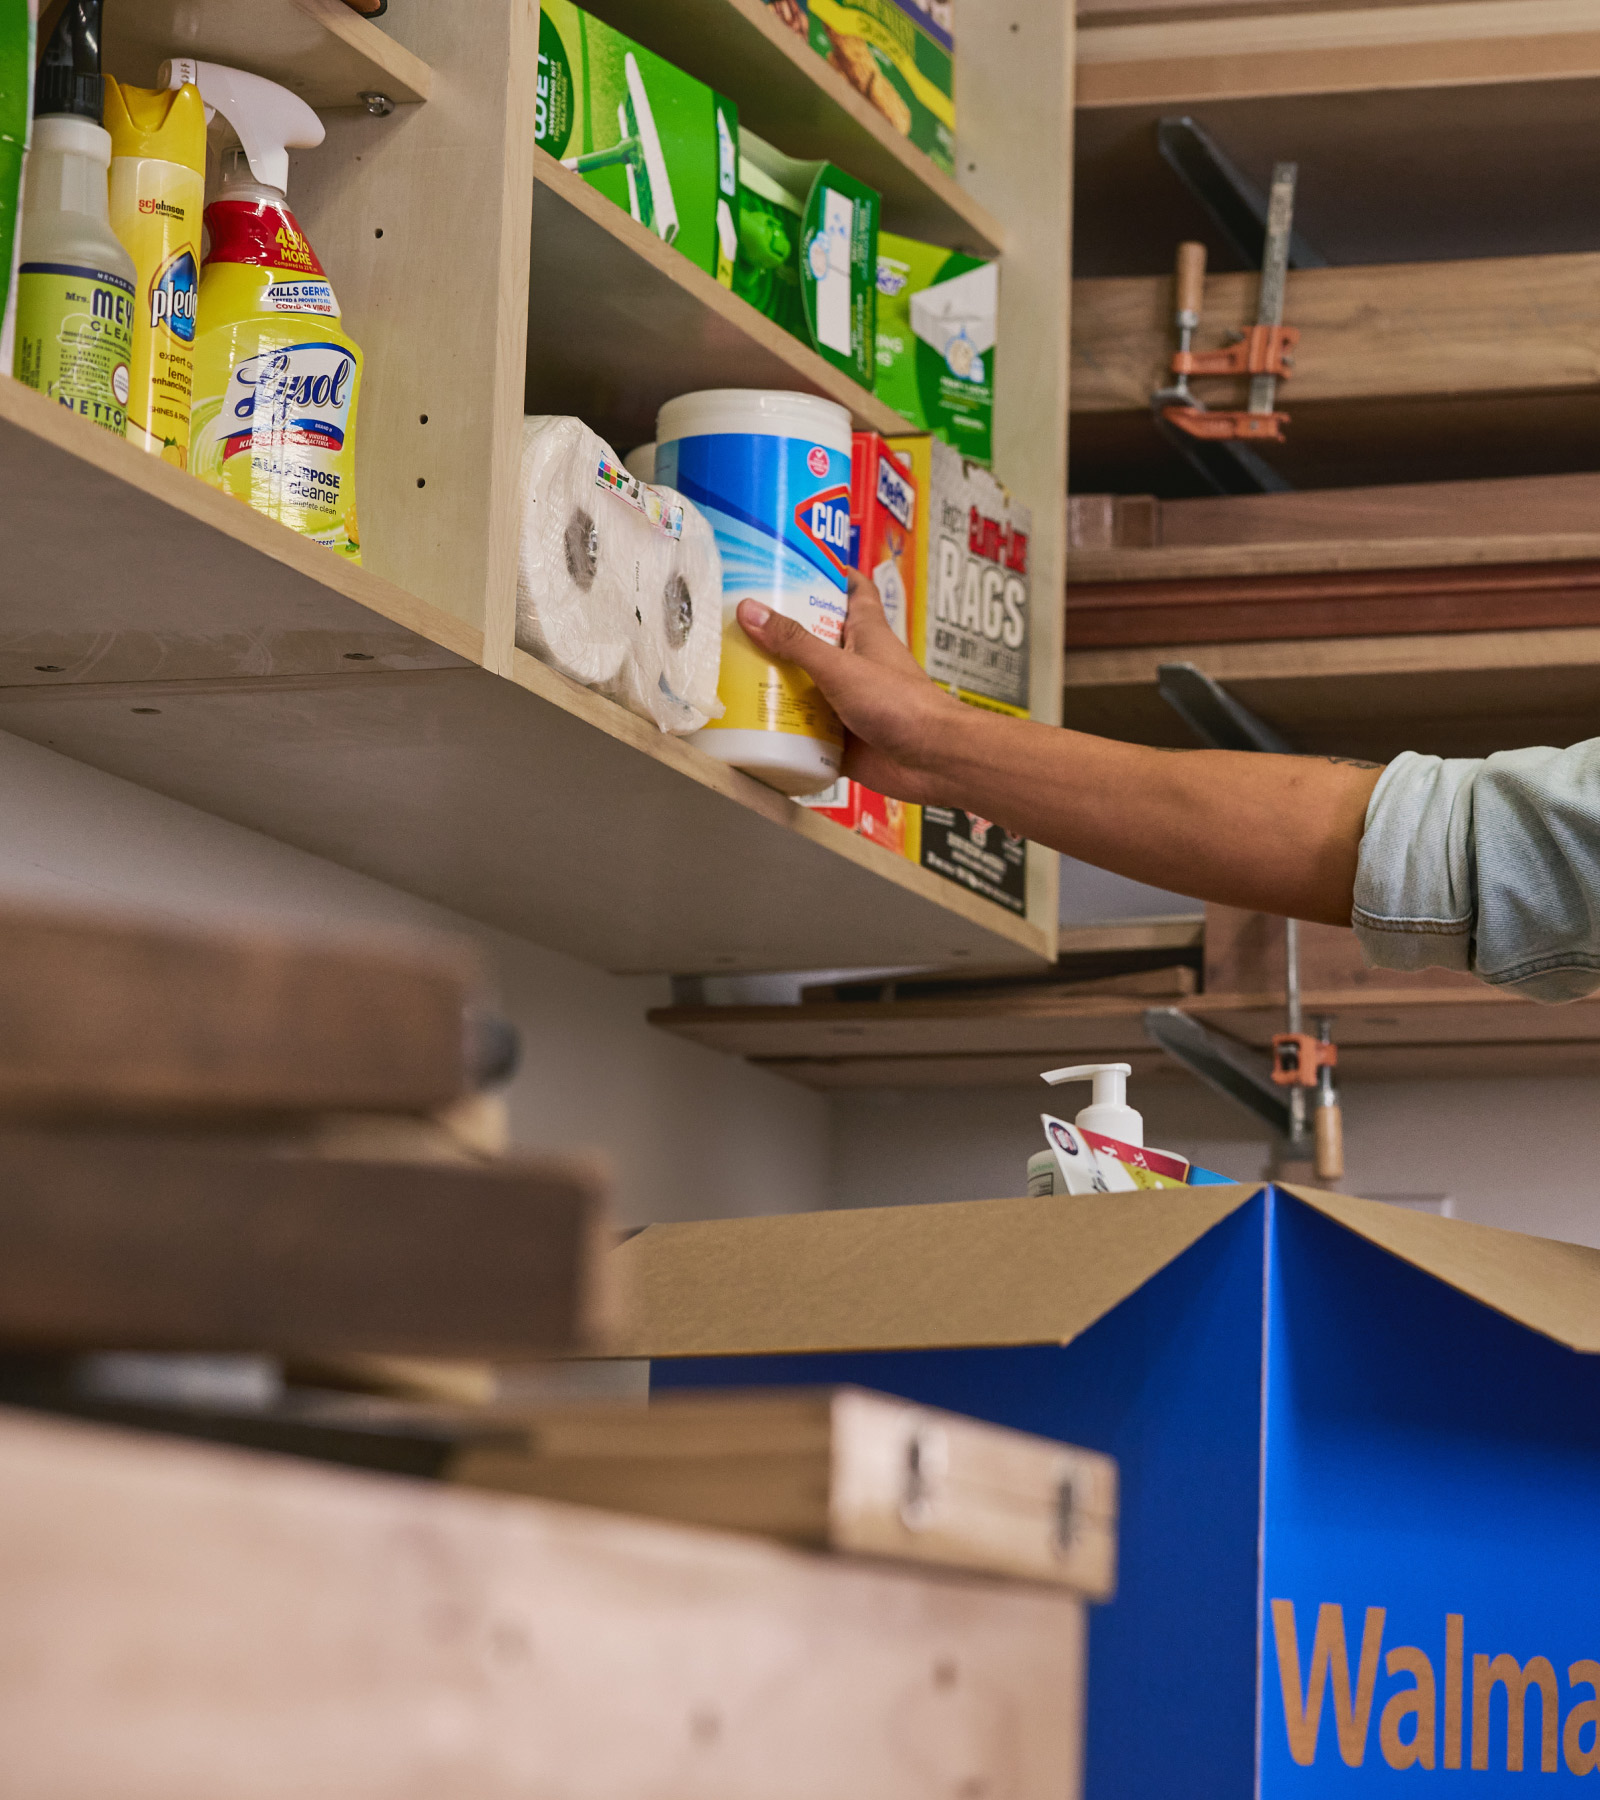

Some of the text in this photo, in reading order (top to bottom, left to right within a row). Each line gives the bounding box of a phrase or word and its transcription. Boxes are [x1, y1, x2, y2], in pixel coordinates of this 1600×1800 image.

[275, 227, 310, 253] 45%
[280, 248, 313, 266] MORE
[268, 287, 299, 297] KILLS
[66, 287, 135, 330] Mrs. MEY
[151, 280, 197, 328] pledg
[159, 351, 186, 367] expert
[152, 377, 186, 394] enhancing
[235, 354, 349, 426] Lysol
[289, 482, 339, 505] cleaner
[320, 503, 337, 515] clean
[936, 535, 1027, 650] RAGS
